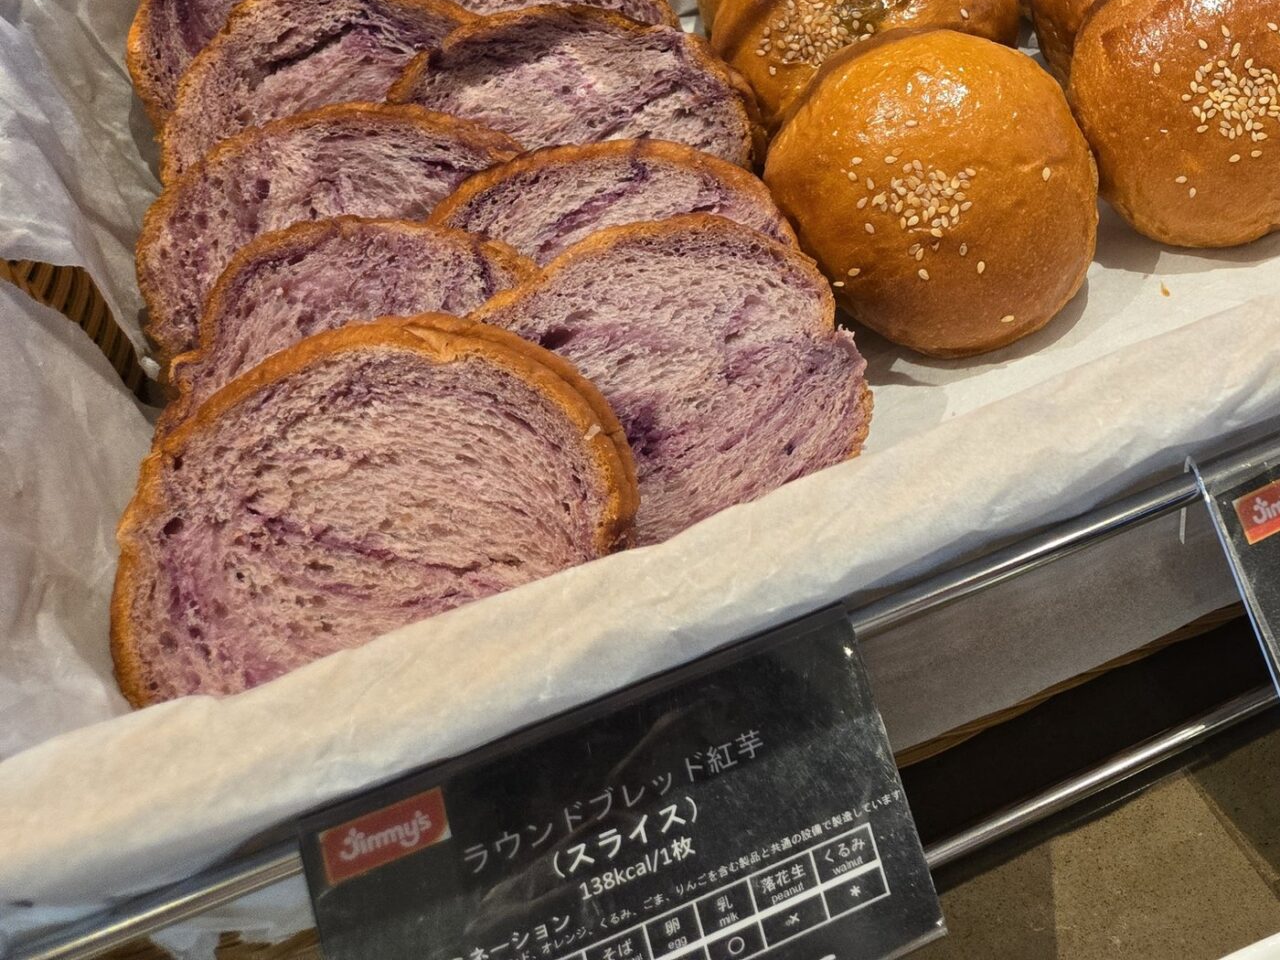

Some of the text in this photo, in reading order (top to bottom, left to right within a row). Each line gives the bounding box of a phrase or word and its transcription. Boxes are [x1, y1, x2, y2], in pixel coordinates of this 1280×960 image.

[464, 730, 764, 873] ラウンドブレッド紅芋
[340, 810, 432, 861] Jimmy's
[824, 837, 866, 863] くるみ
[579, 836, 696, 901] 138kcal/1枚
[832, 855, 864, 876] walnut
[761, 864, 806, 894] 落花生
[716, 896, 733, 913] 乳
[771, 883, 805, 905] peanut
[664, 917, 681, 936] 卵
[719, 912, 740, 928] milk
[452, 915, 570, 960] ネーション
[667, 936, 688, 950] egg
